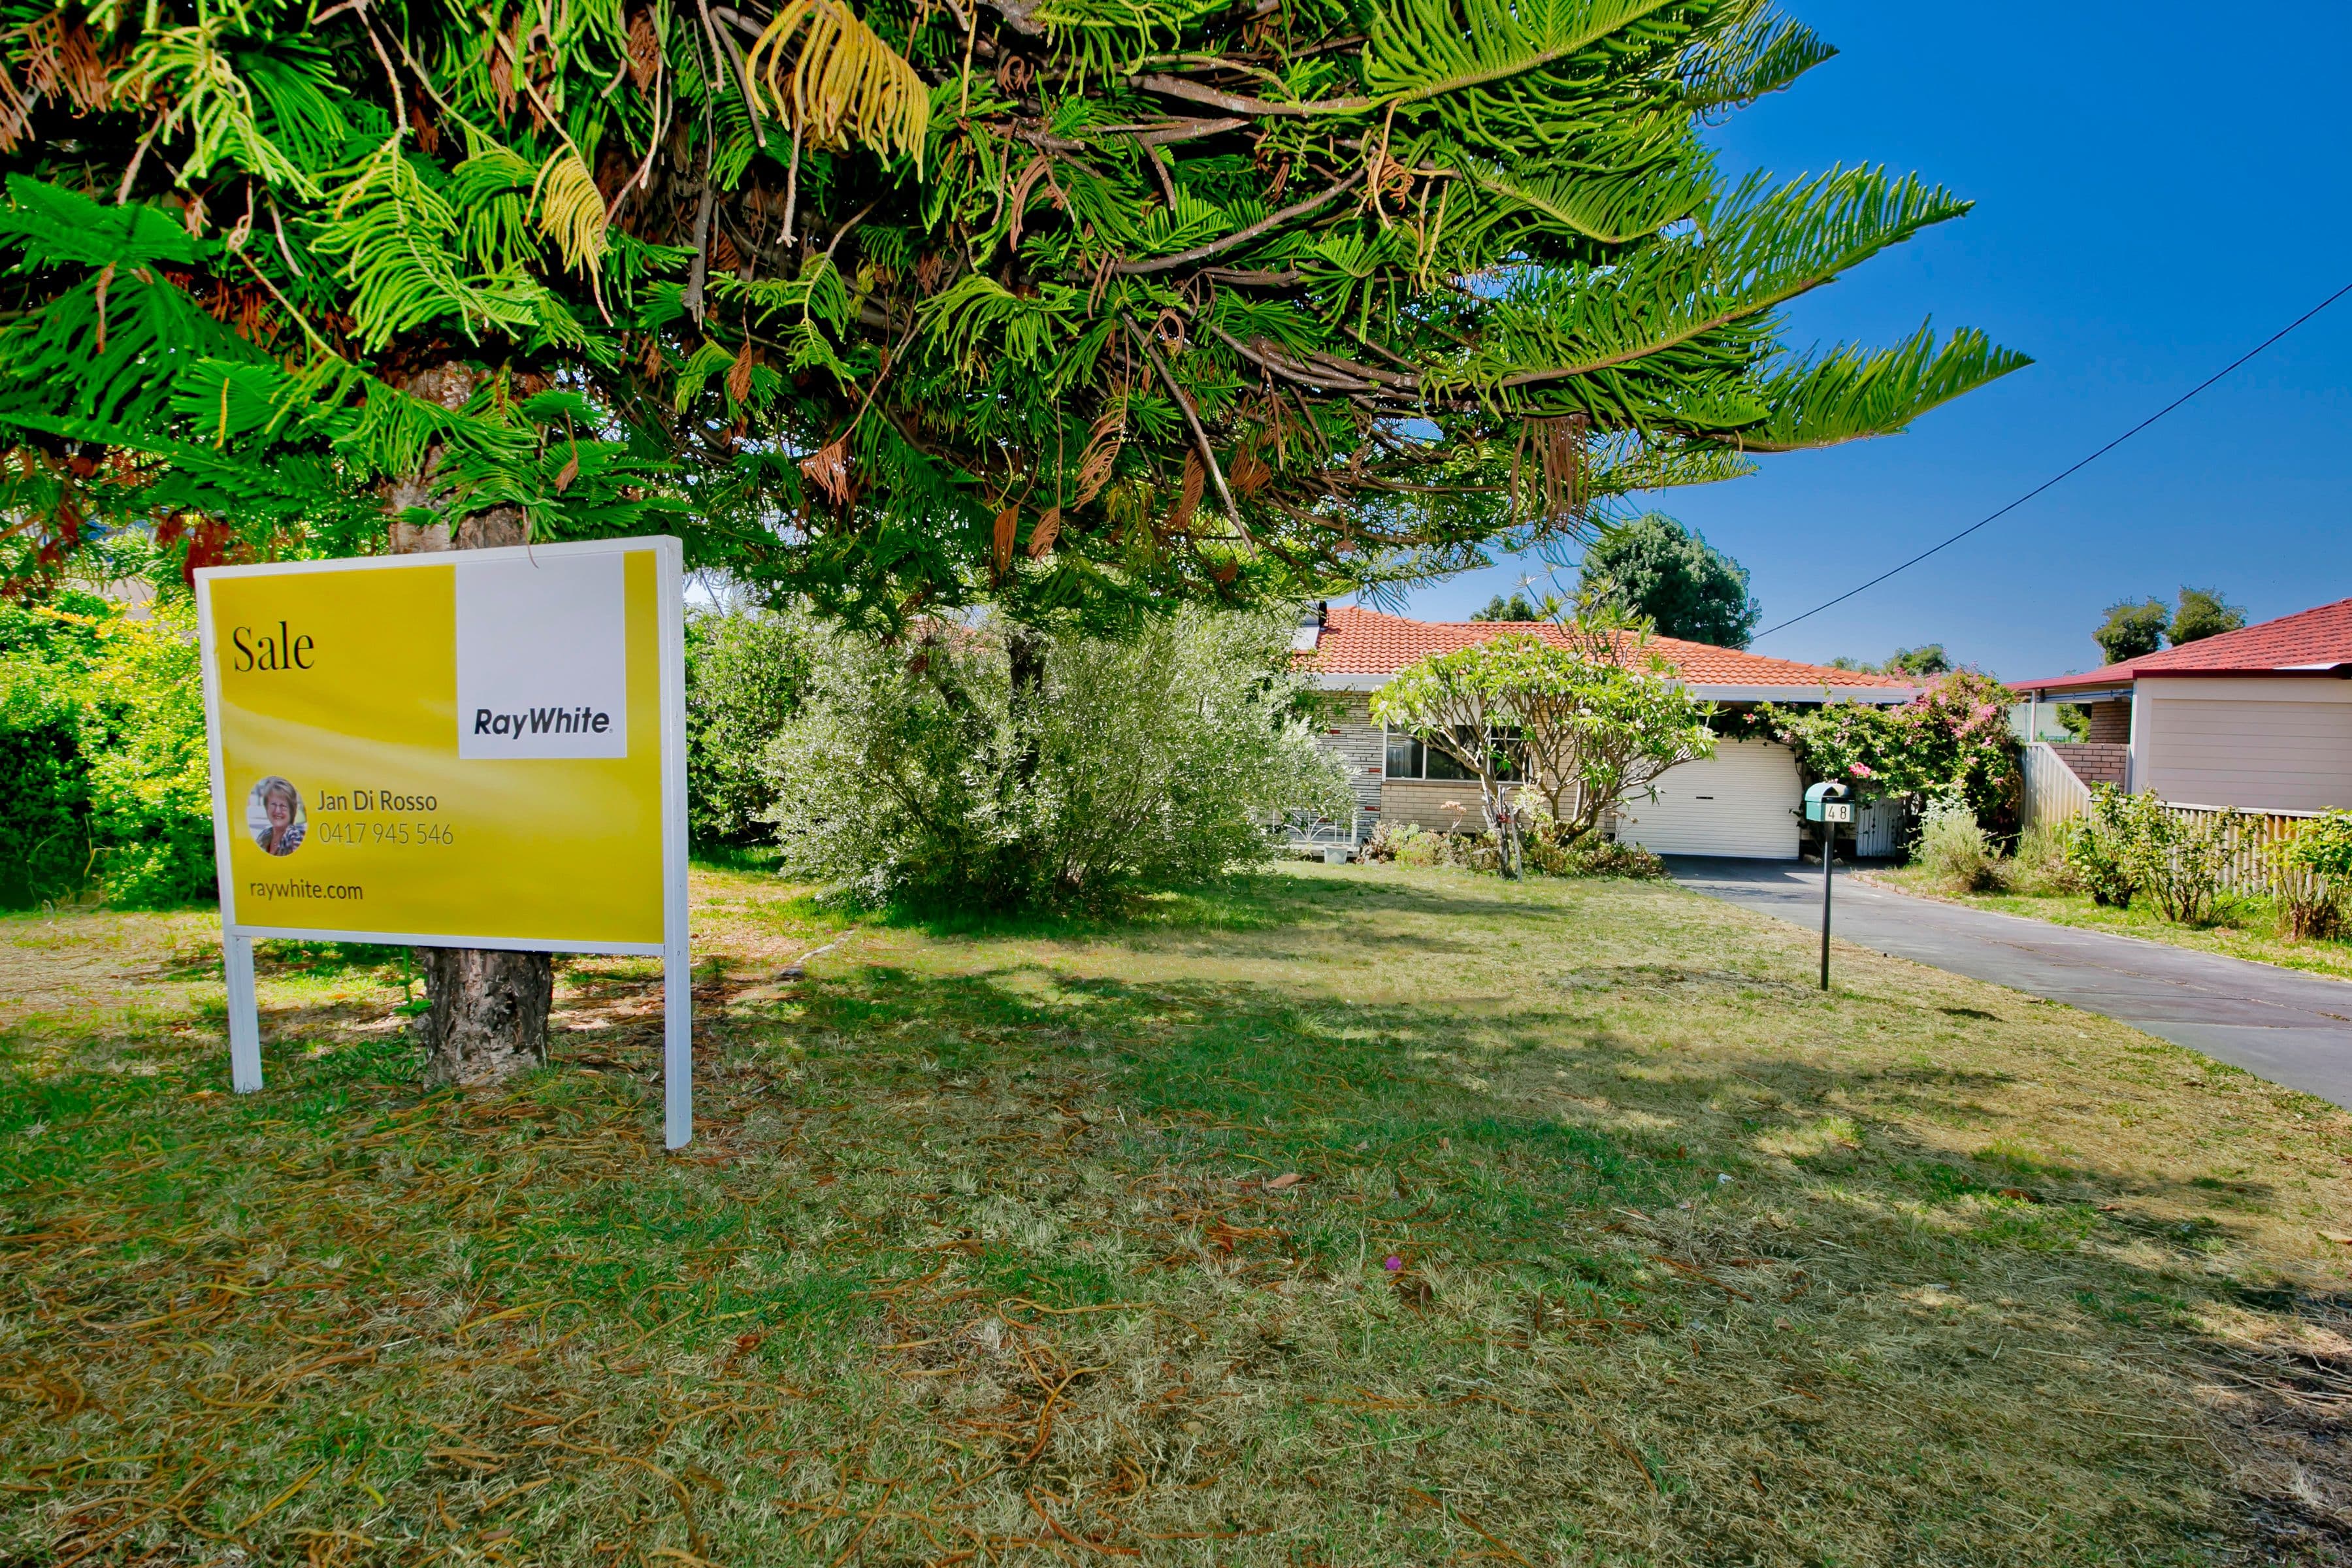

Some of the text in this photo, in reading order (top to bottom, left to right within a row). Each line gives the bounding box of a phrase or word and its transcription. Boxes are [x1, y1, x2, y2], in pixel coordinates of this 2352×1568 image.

[233, 620, 315, 672] Sale
[318, 789, 437, 811] Jan Di Rosso
[319, 822, 453, 845] 0417 945 546
[250, 878, 363, 901] raywhite.com
